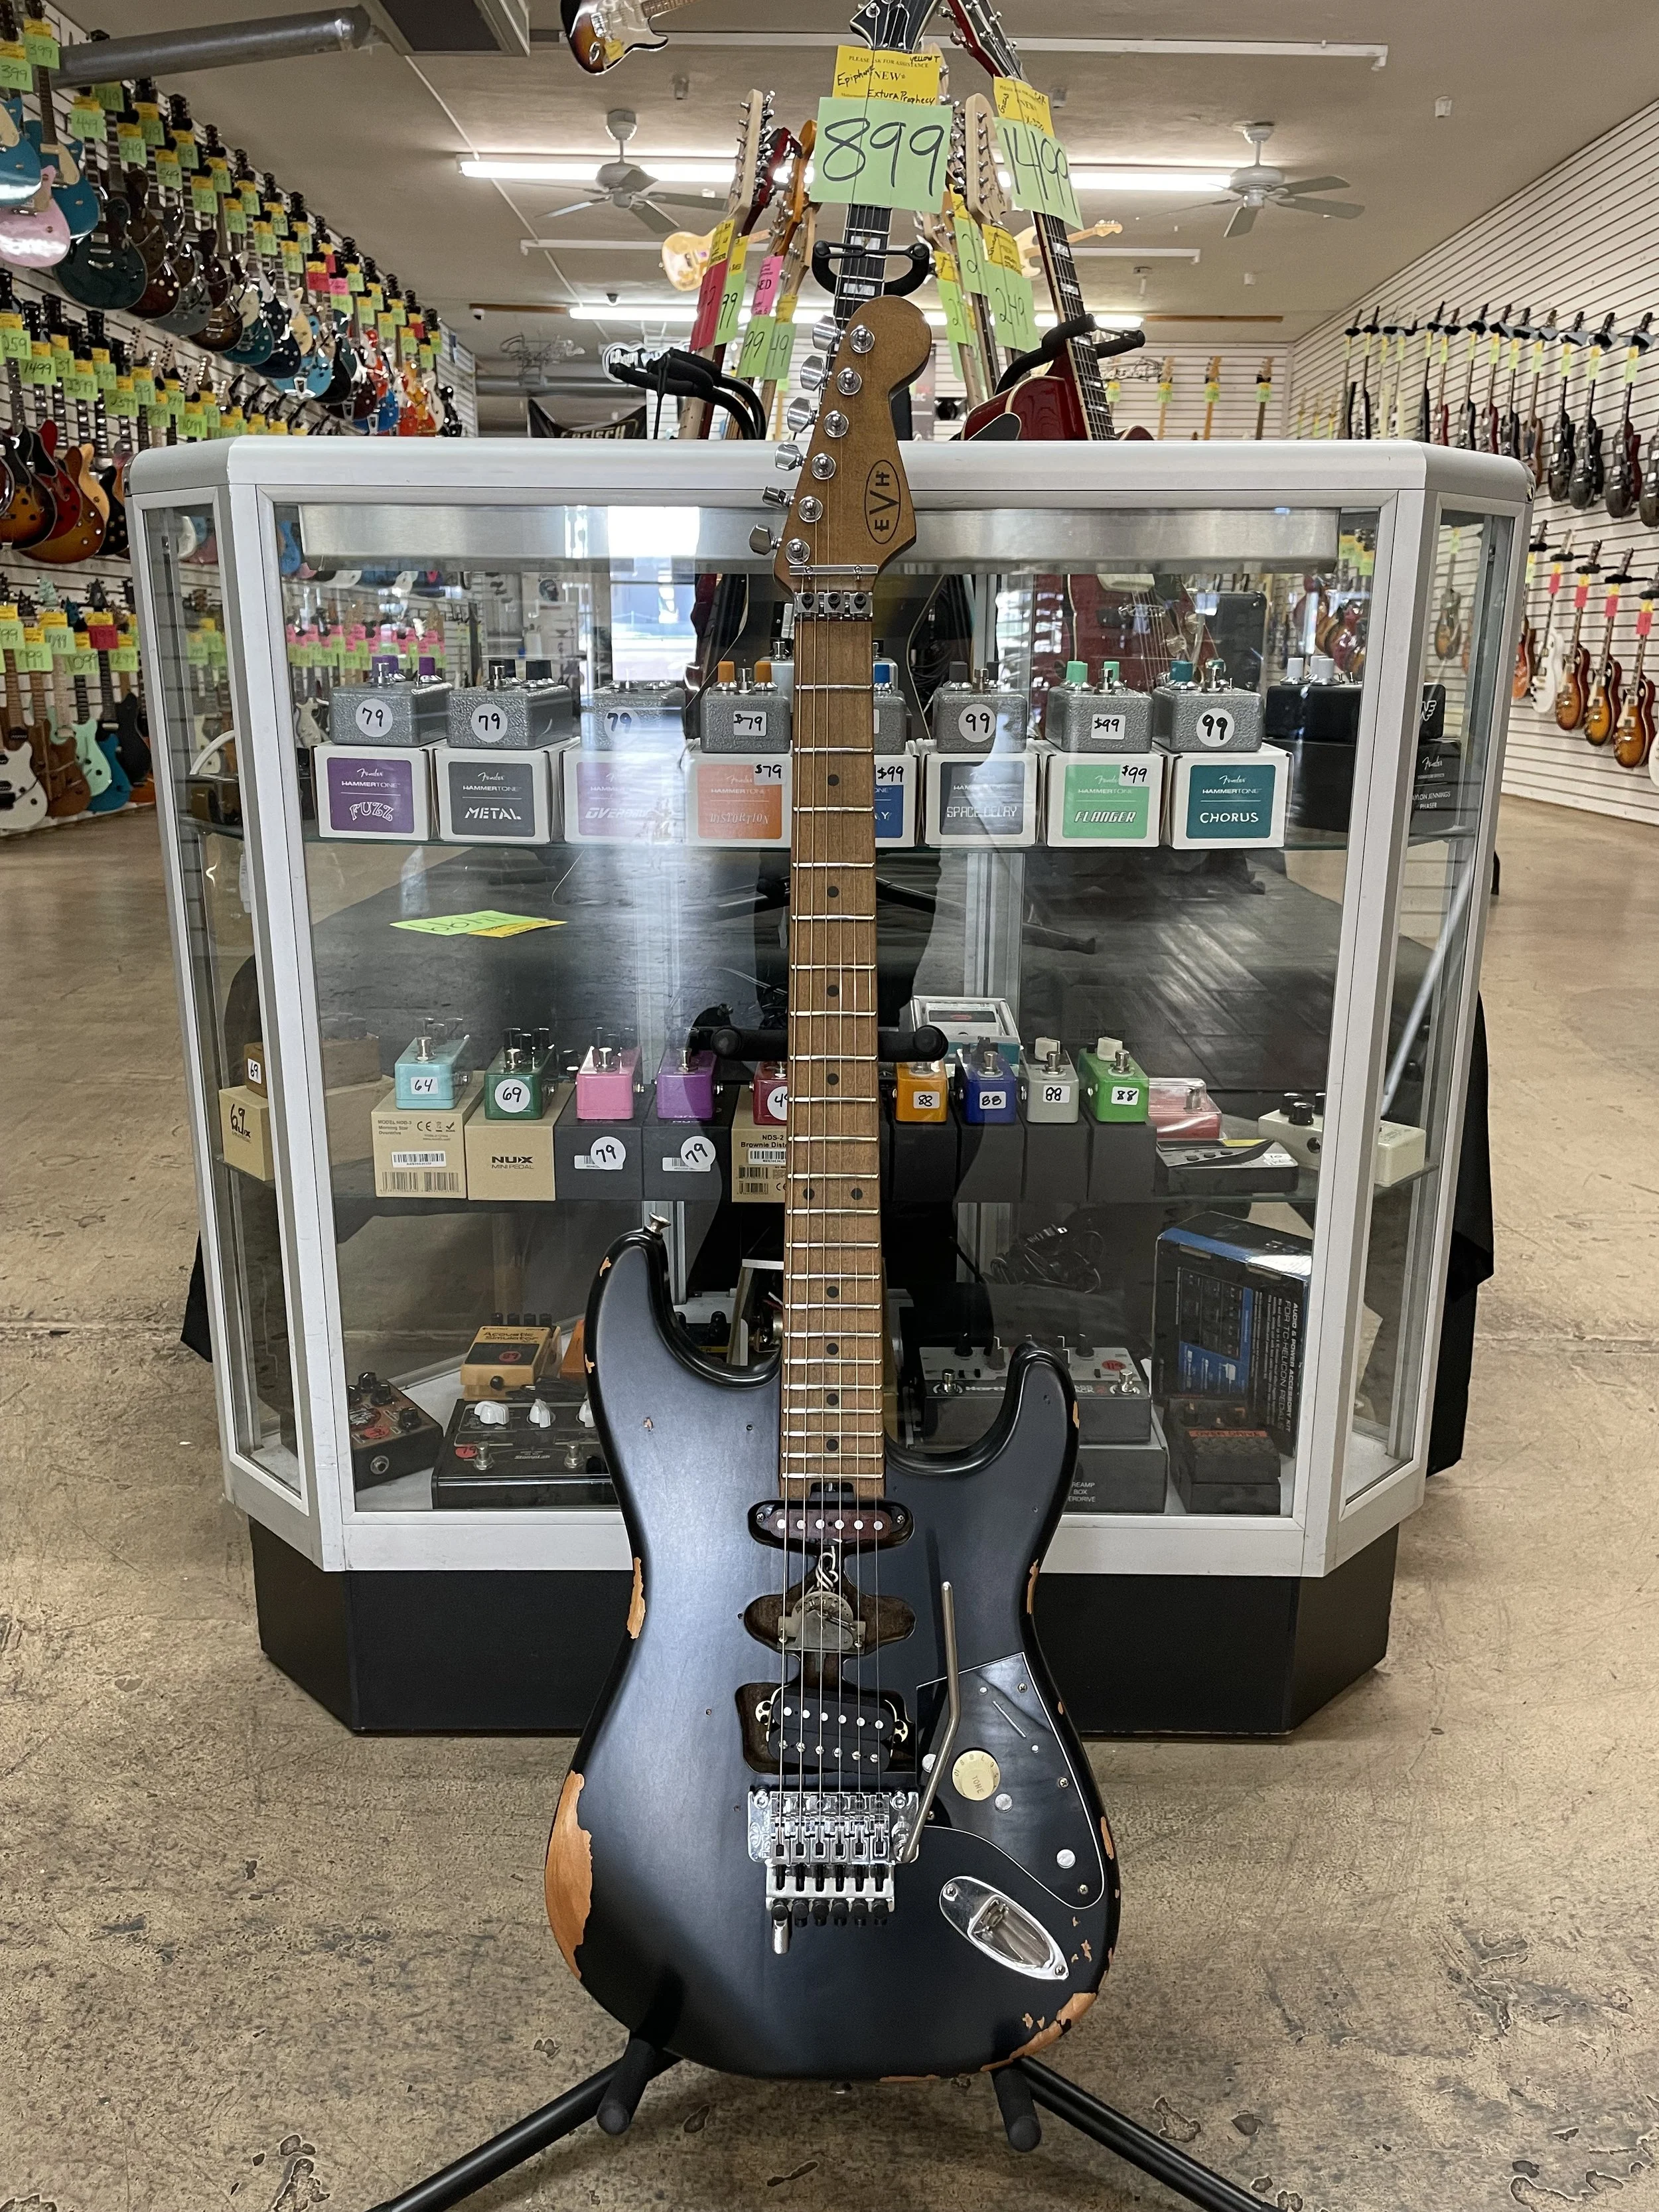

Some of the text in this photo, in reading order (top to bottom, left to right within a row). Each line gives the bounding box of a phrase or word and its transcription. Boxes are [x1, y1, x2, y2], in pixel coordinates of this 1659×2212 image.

[823, 118, 944, 197] 899
[1003, 127, 1079, 220] 1499
[869, 472, 900, 532] EVH
[362, 707, 384, 727] 79
[478, 713, 500, 731] 79
[607, 712, 632, 734] 79
[966, 712, 990, 733] 99
[1094, 717, 1120, 733] $99
[1202, 714, 1228, 741] 99
[356, 768, 383, 778] Fender
[478, 772, 505, 782] Fender
[877, 765, 904, 783] $99
[1121, 765, 1147, 784] $99
[1219, 774, 1247, 785] Fender
[349, 801, 395, 822] FUZZ
[465, 807, 522, 820] METAL
[709, 812, 770, 824] DISTORTION
[947, 806, 1017, 818] SPACE DELAY
[1074, 811, 1137, 823] FLANGER
[1200, 812, 1260, 824] CHORUS
[250, 1062, 259, 1080] 69
[414, 1078, 433, 1093] 64
[502, 1086, 522, 1103] 69
[492, 1155, 534, 1164] NUX
[596, 1144, 616, 1163] 79
[685, 1143, 708, 1163] 79
[1286, 1368, 1295, 1418] ACCESSORY
[972, 1775, 984, 1795] TONE
